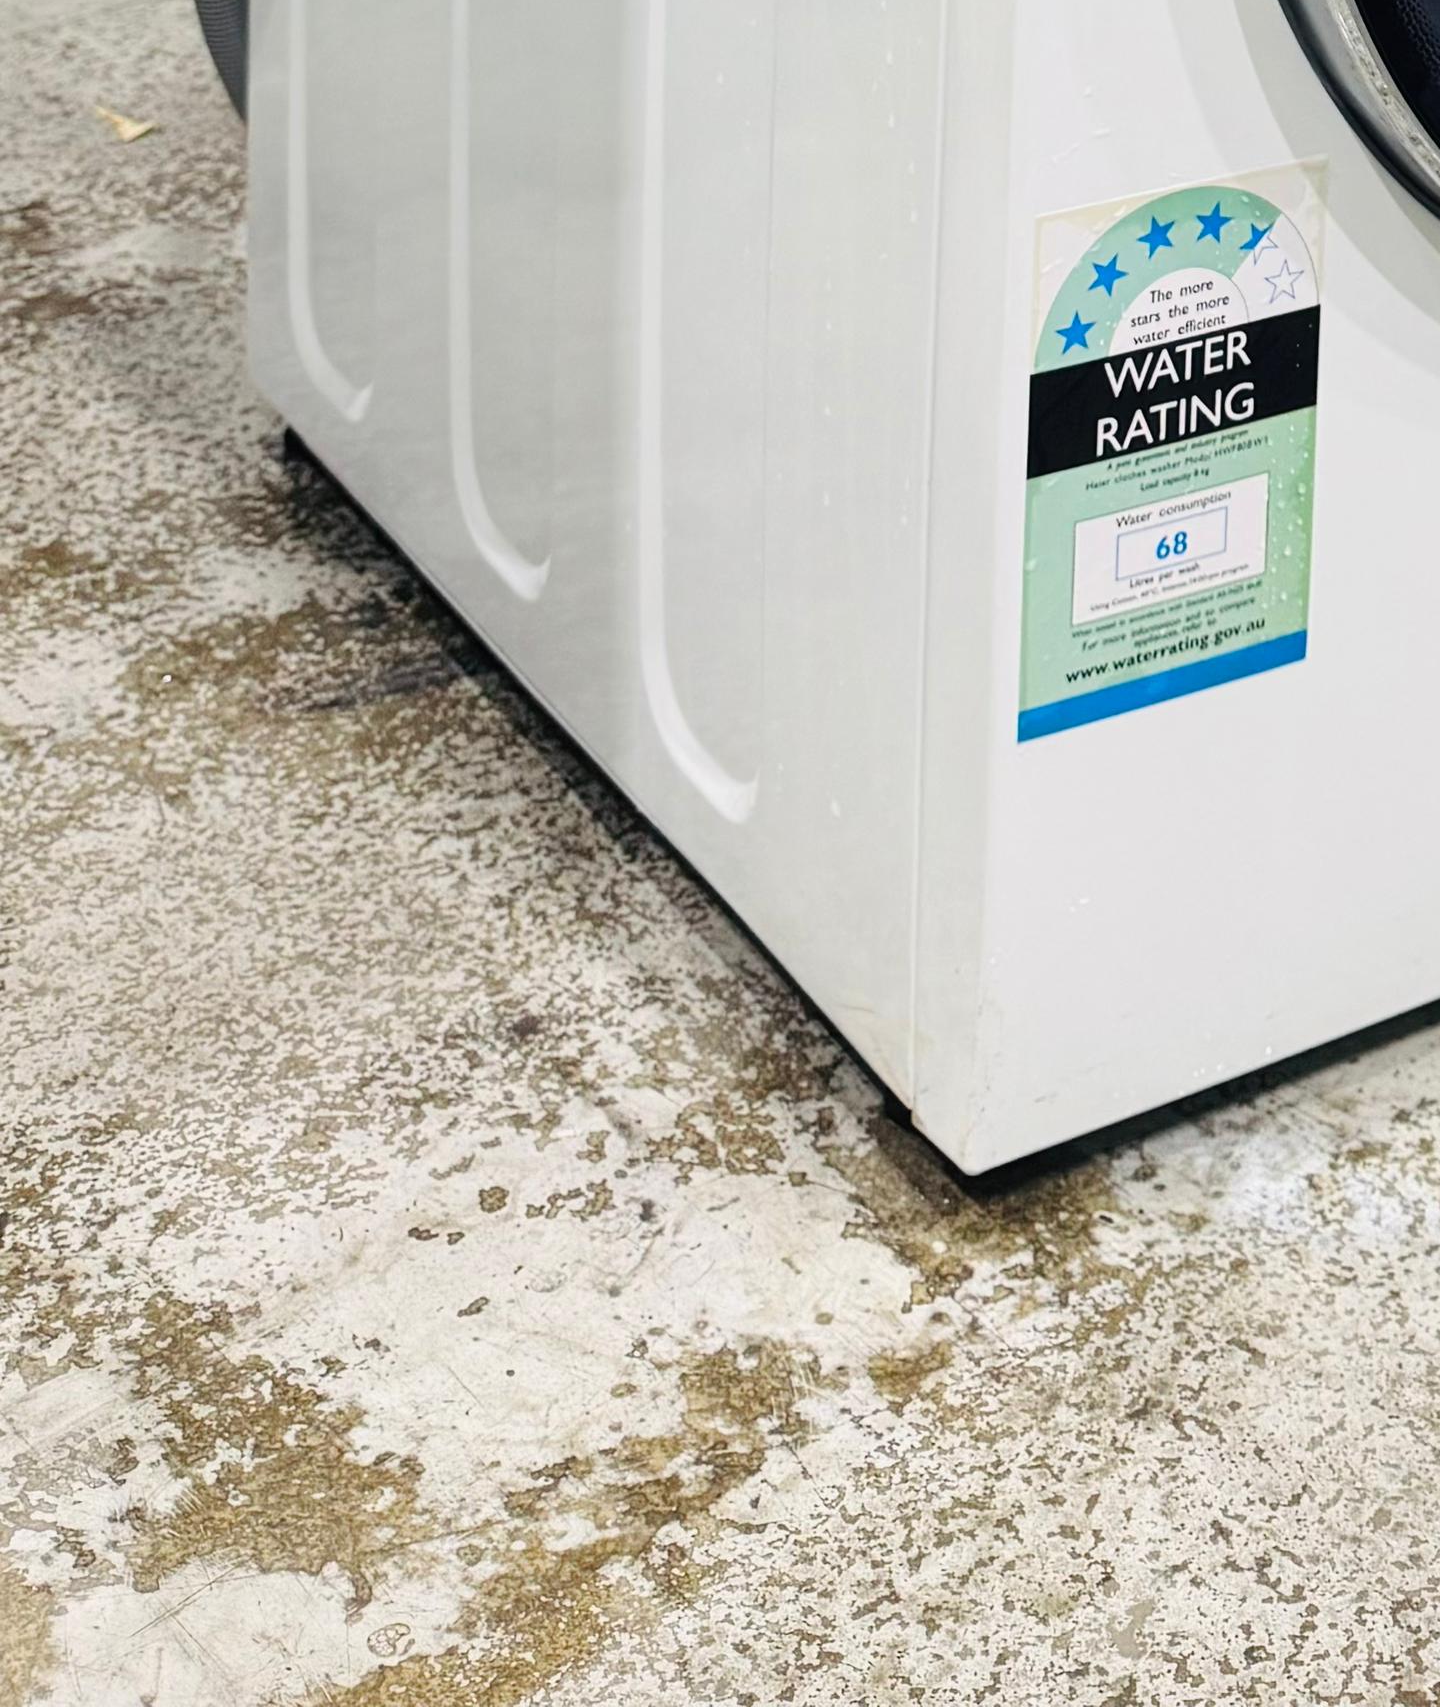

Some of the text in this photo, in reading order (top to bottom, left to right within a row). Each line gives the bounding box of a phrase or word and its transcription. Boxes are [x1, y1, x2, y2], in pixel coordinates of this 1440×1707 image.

[1149, 280, 1214, 305] The more
[1130, 293, 1230, 328] stars the more
[1132, 314, 1226, 346] water efficient
[1104, 330, 1251, 398] WATER
[1095, 382, 1255, 457] RATING
[1115, 490, 1232, 529] Water consumption
[1156, 530, 1188, 560] 68
[1129, 562, 1200, 588] Litres per wash
[1066, 618, 1266, 684] www.waterrating.gov.au
